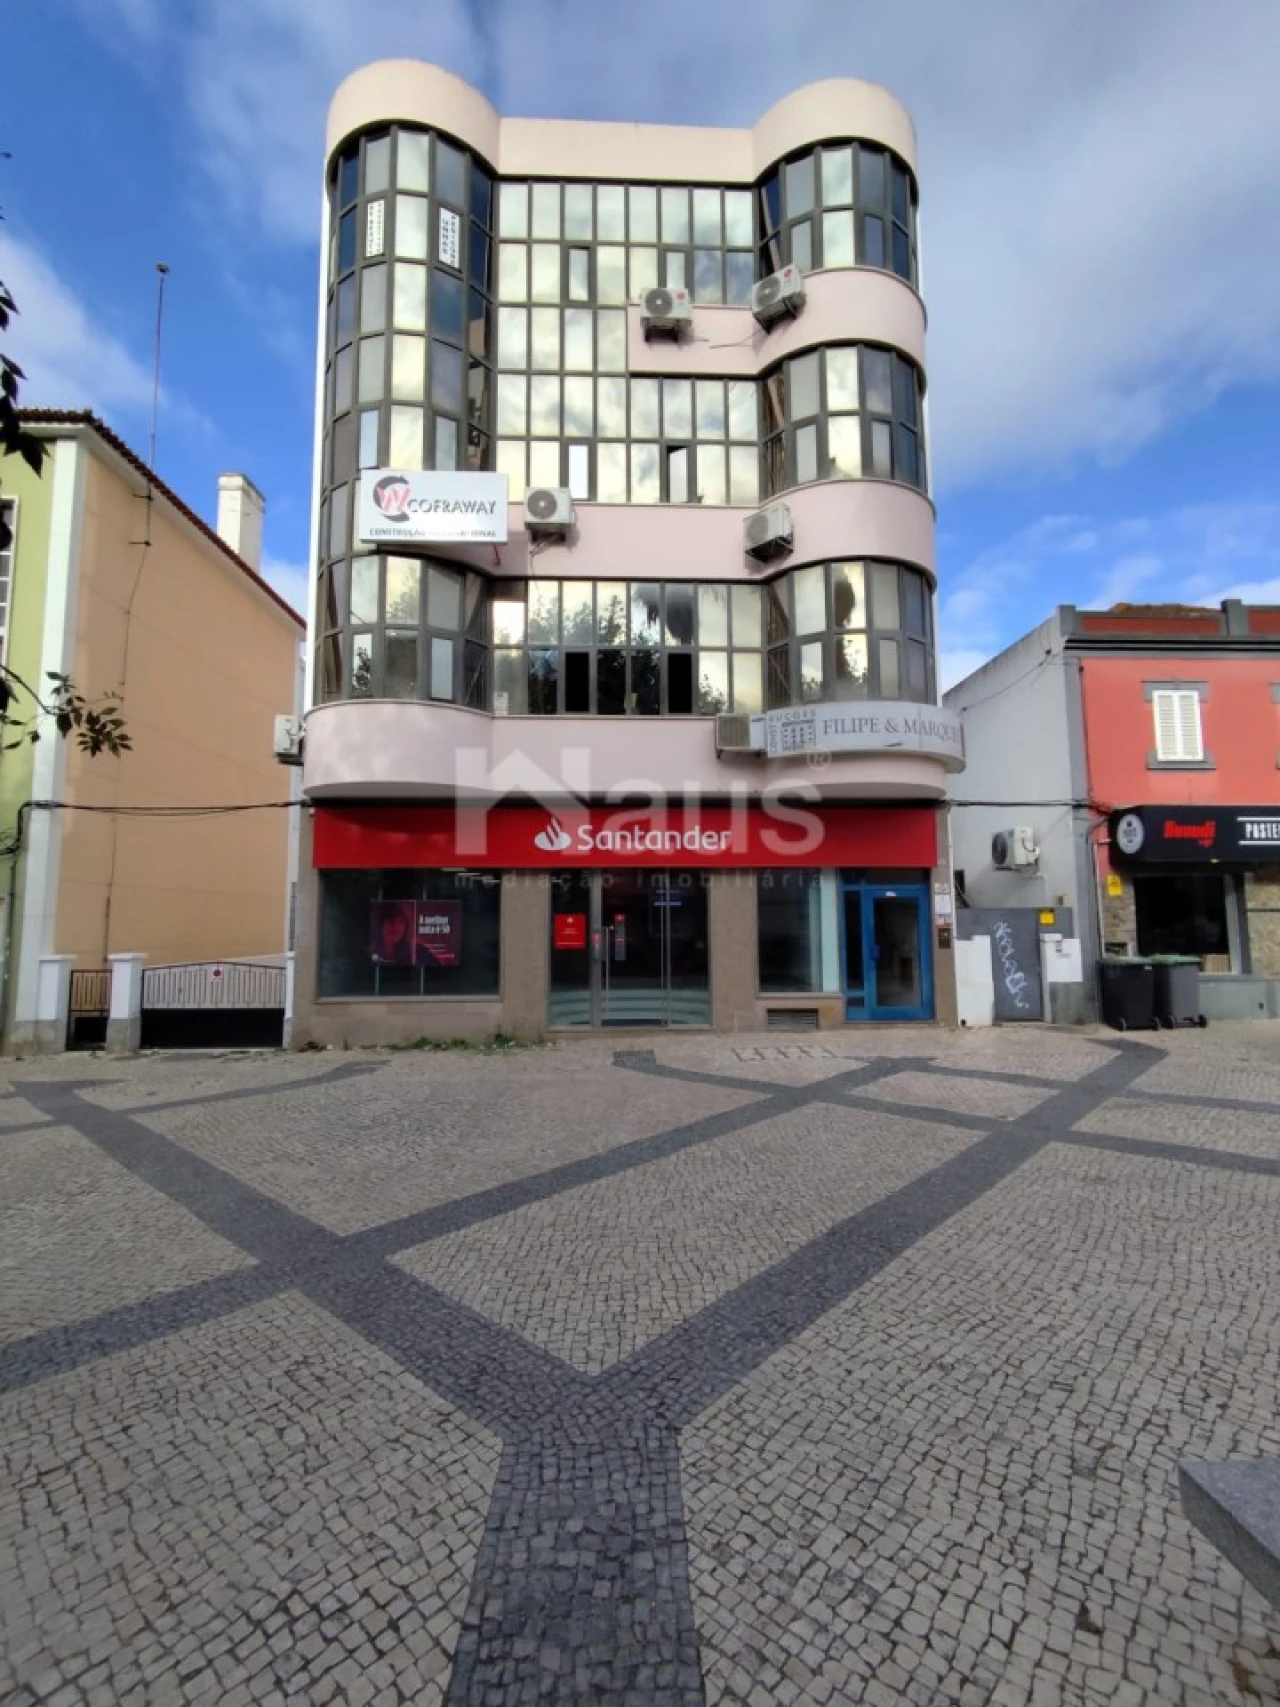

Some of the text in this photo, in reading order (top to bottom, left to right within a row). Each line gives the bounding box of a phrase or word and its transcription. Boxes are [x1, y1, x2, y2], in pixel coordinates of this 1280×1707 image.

[407, 498, 497, 514] COFRAWAY
[822, 717, 880, 735] FILIPE
[884, 718, 898, 733] &
[577, 825, 731, 852] Santander
